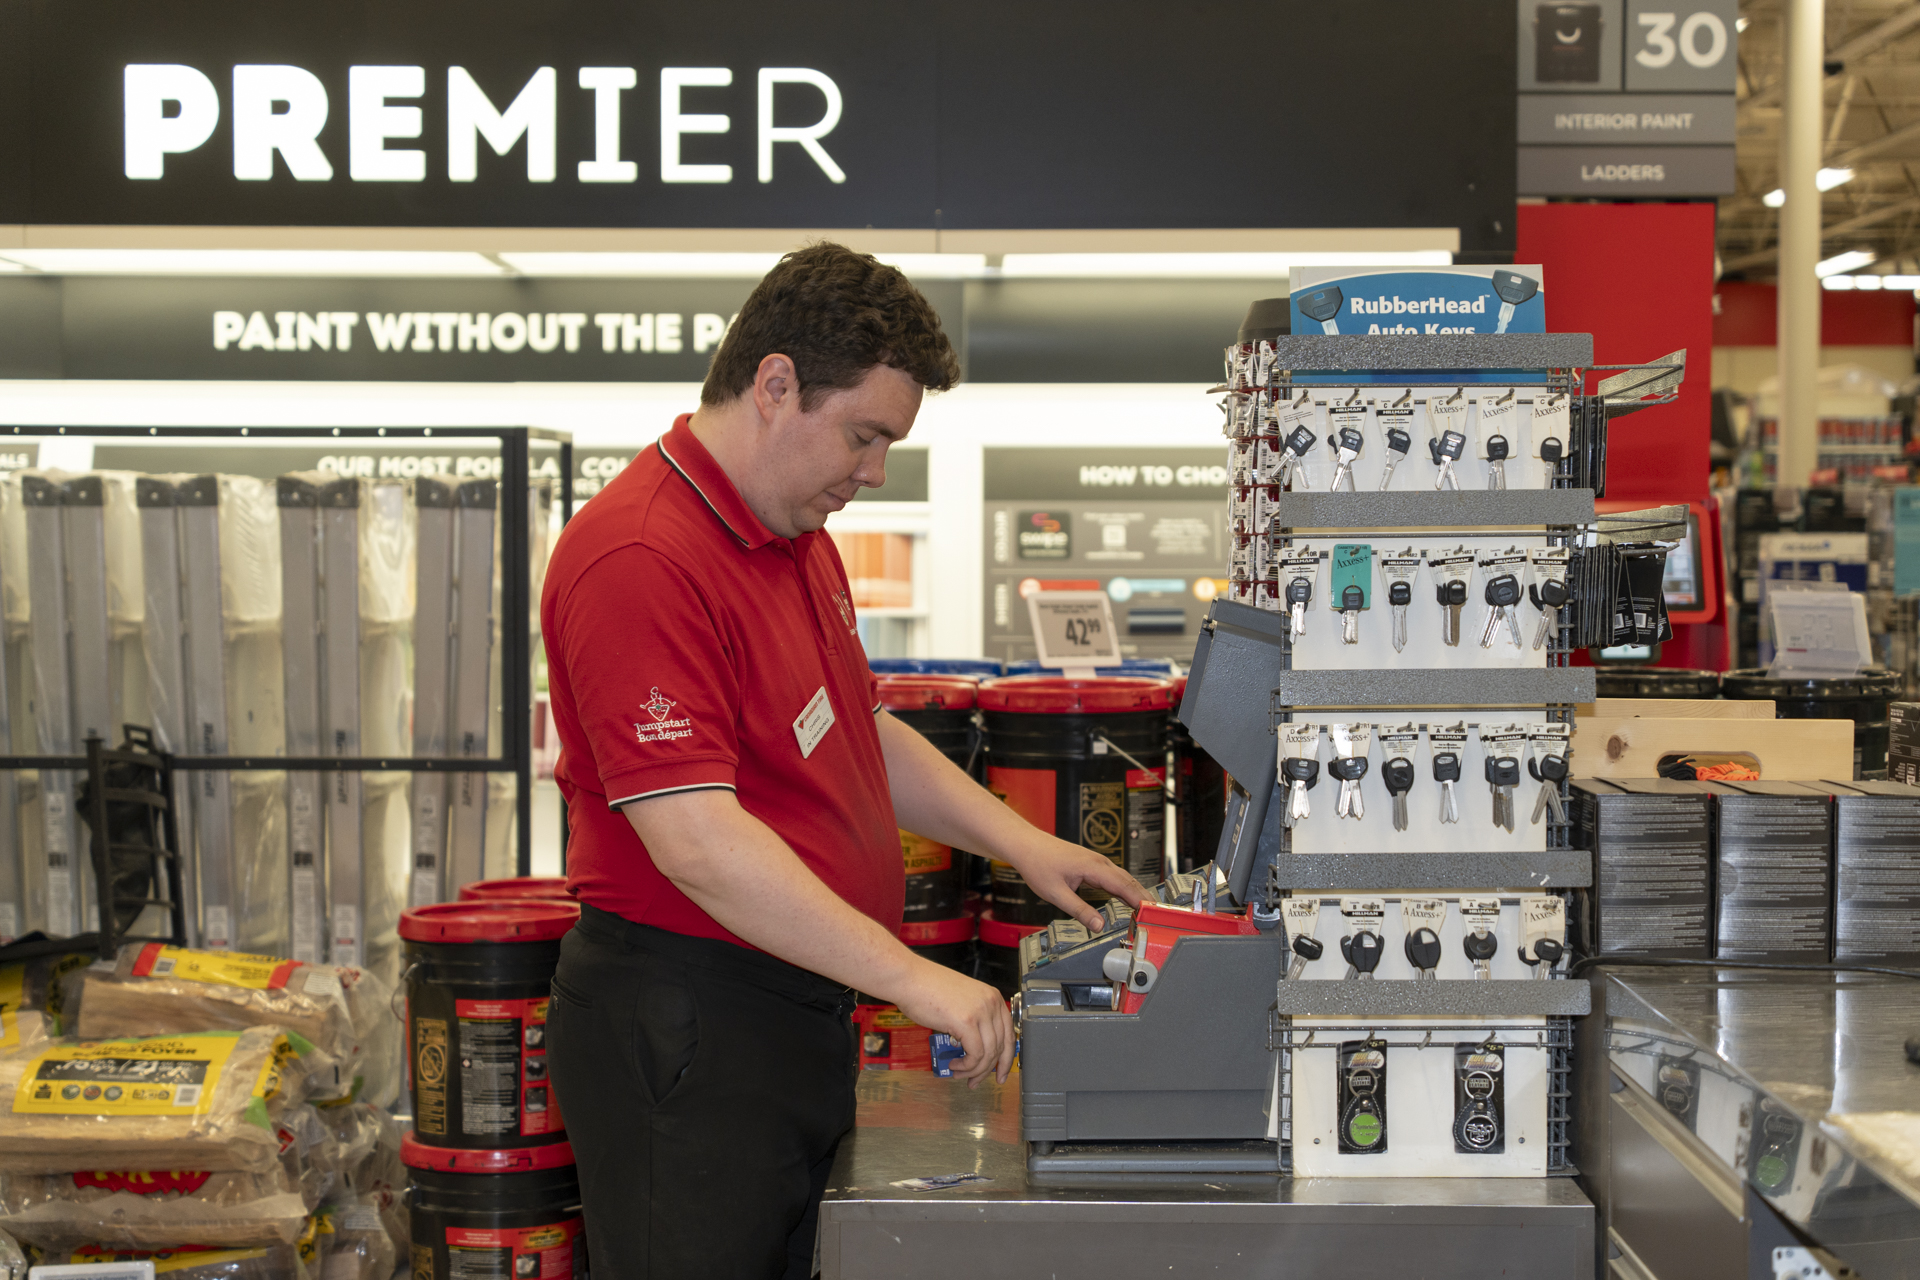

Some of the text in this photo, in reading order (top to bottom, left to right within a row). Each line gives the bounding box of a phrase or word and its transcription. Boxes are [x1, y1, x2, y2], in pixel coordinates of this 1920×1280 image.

[1635, 12, 1727, 68] 30
[124, 64, 846, 184] PREMIER
[1555, 114, 1693, 129] INTERIOR PAINT
[1582, 165, 1665, 180] LADDERS
[212, 311, 358, 351] PAINT
[366, 312, 587, 353] WITHOUT
[595, 313, 682, 353] THE
[317, 456, 373, 478] OUR
[380, 456, 450, 478] MOST
[1080, 466, 1228, 486] HOW TO CHO
[1066, 618, 1091, 645] 42
[633, 717, 691, 735] Jumpstart
[808, 714, 821, 732] CHRIS
[811, 717, 830, 742] TRAINING
[637, 728, 693, 743] Bon départ
[910, 856, 942, 868] ASPHALTE
